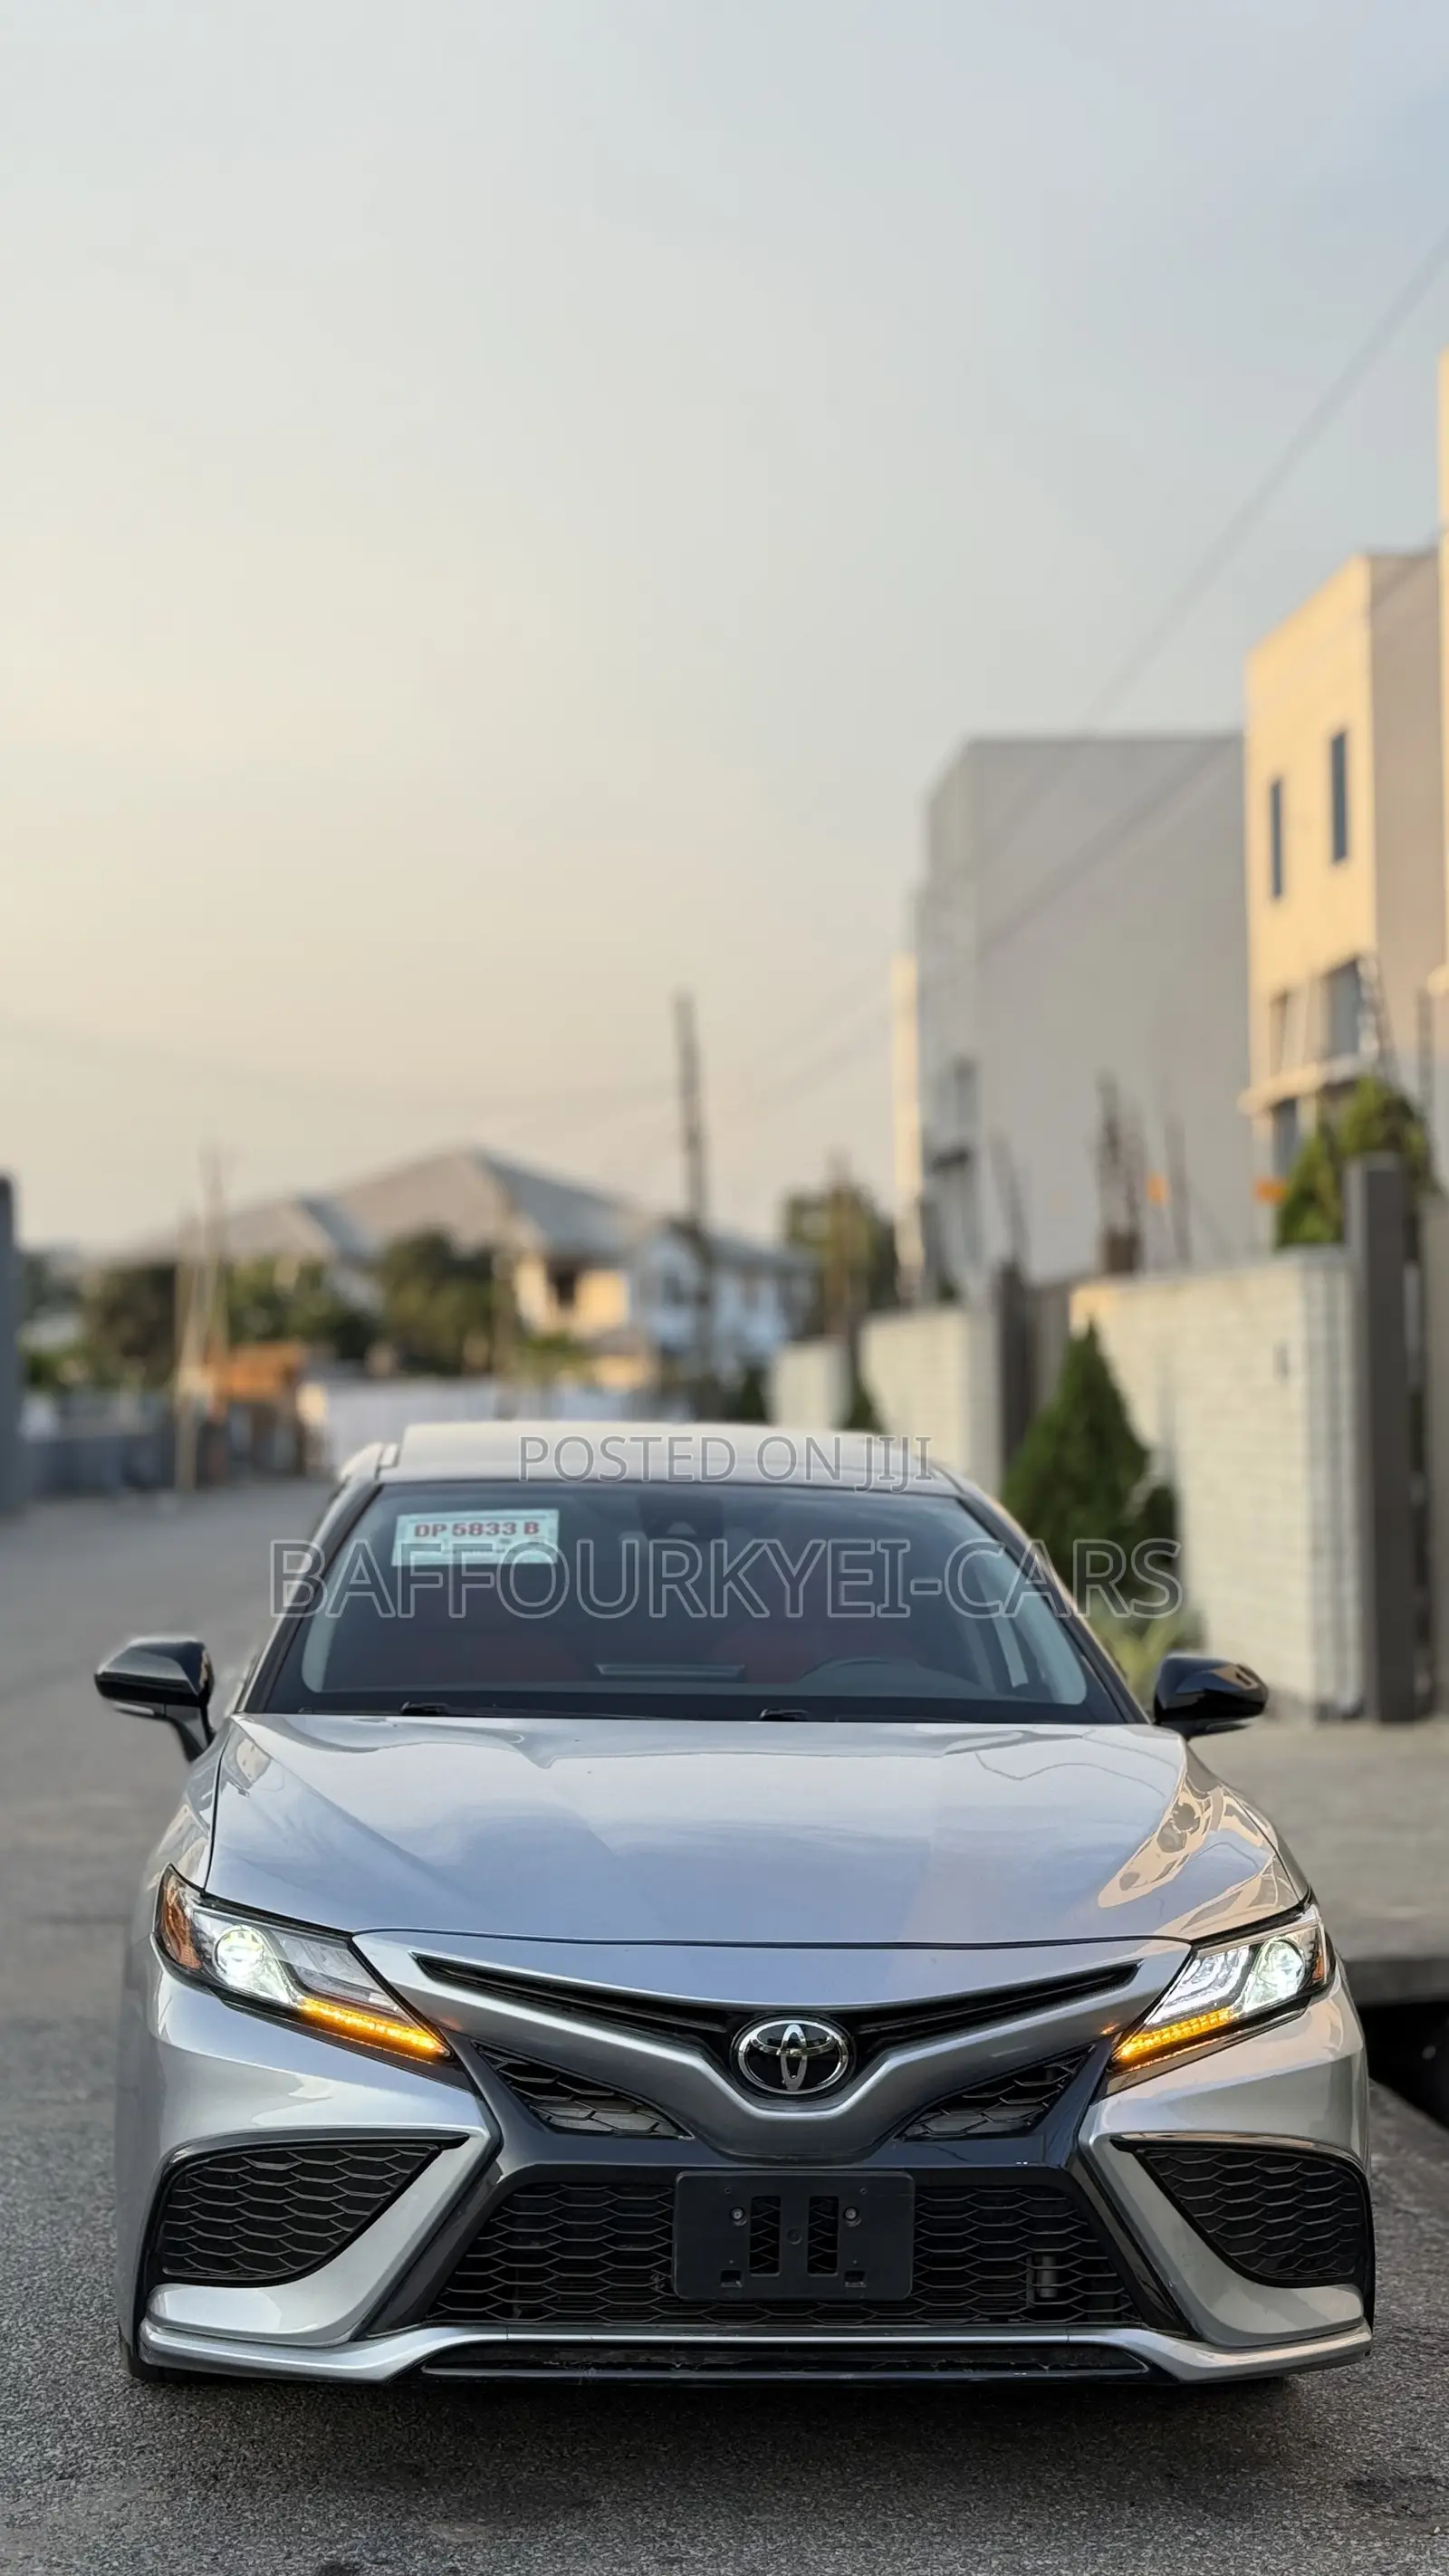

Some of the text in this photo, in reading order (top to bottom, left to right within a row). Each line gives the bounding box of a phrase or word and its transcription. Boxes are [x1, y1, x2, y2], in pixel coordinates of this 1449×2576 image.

[414, 1521, 540, 1537] DP 5833 B
